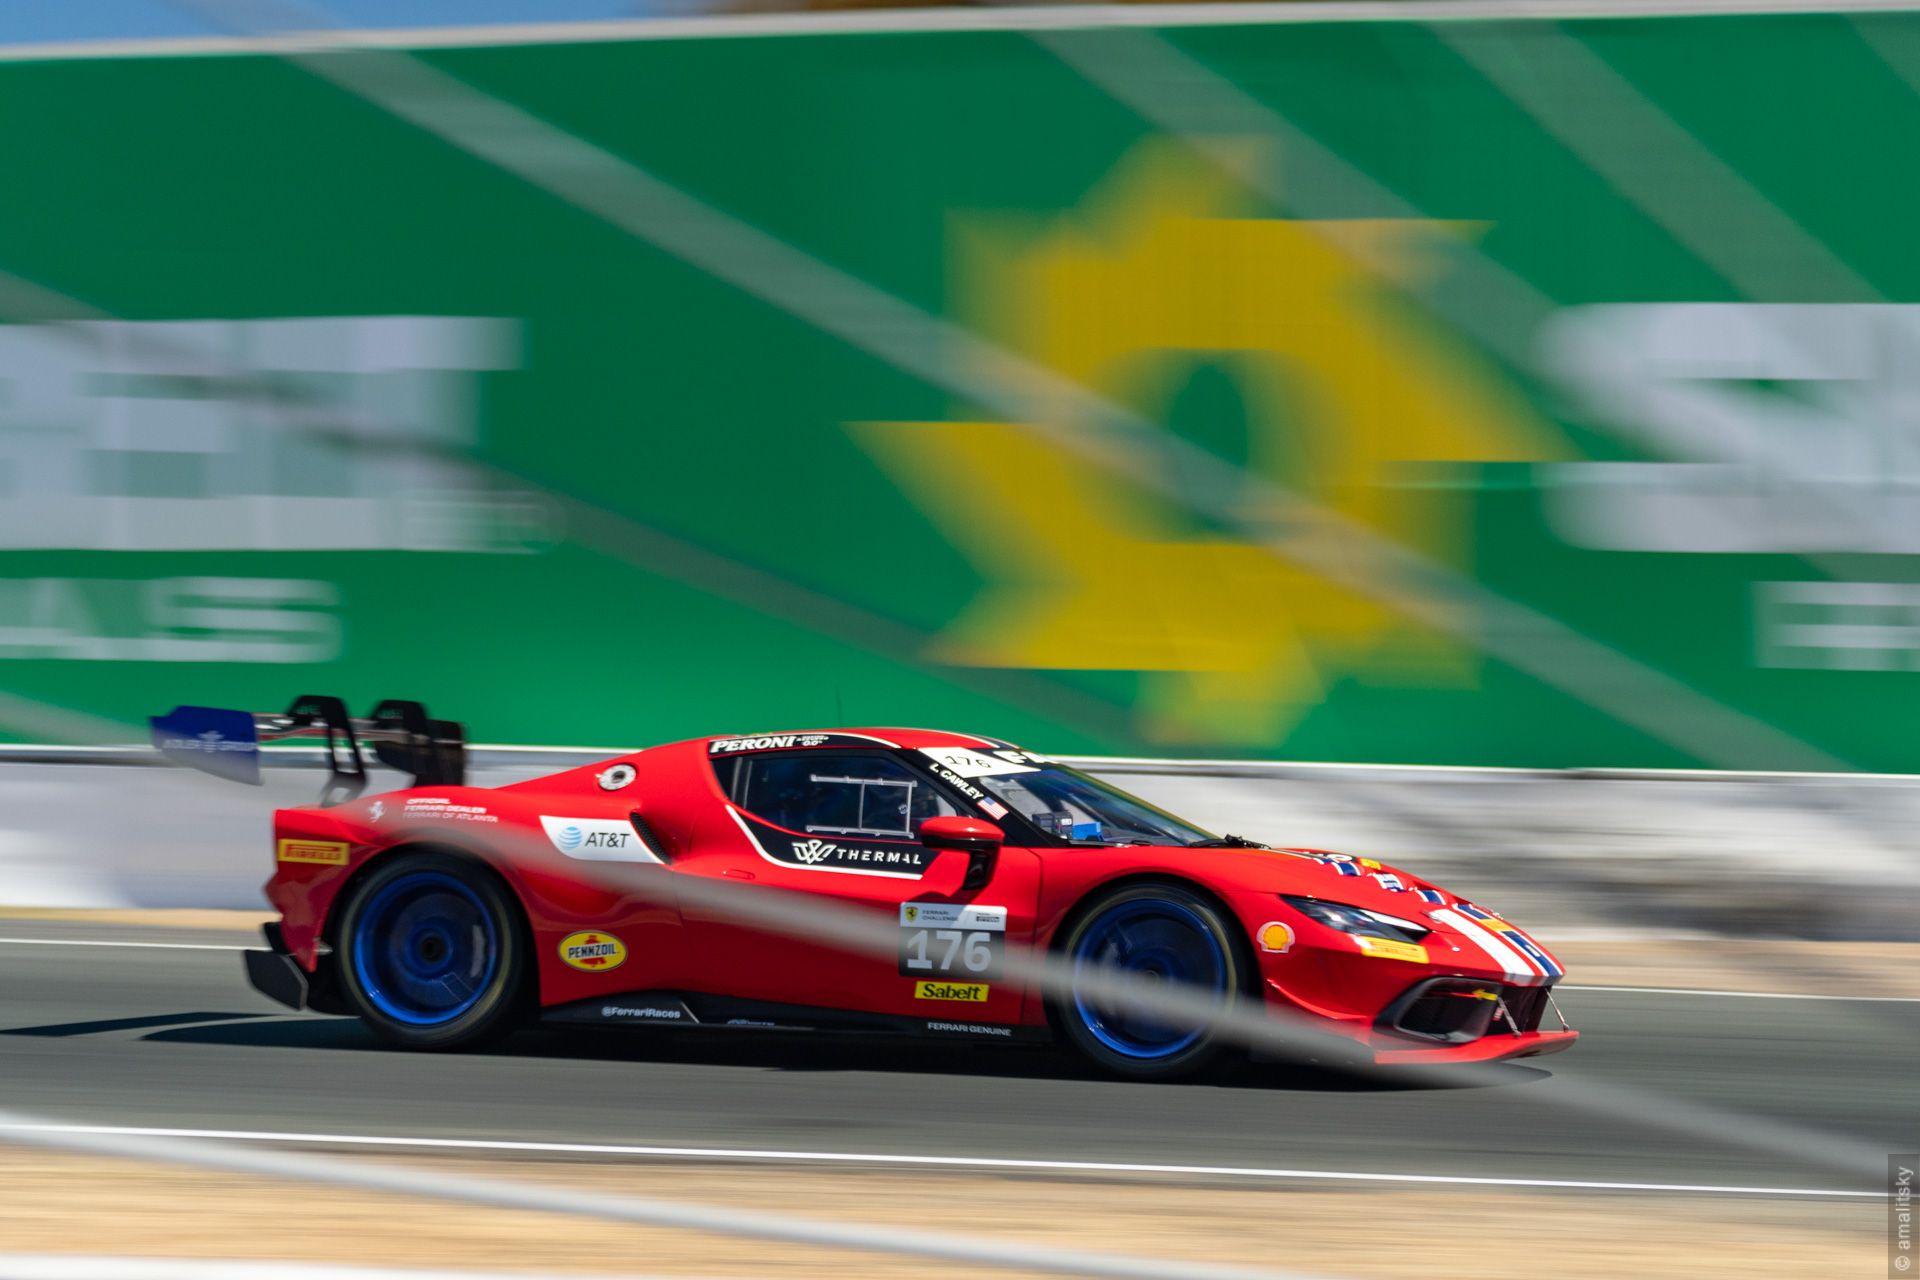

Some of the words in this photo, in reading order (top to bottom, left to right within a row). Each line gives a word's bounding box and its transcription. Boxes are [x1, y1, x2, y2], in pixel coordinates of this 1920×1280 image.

[709, 736, 797, 753] PERONI
[945, 755, 993, 769] 176
[929, 763, 939, 774] L.
[940, 771, 985, 800] CAWLEY
[446, 805, 488, 814] DEALER
[456, 813, 498, 823] ATLANTA
[584, 832, 630, 848] AT&T
[837, 849, 922, 865] THERMAL
[567, 944, 617, 959] PENNZOIL
[907, 929, 992, 972] 176
[922, 983, 981, 1000] Sabelt
[602, 1006, 680, 1019] @FerrariRaces
[927, 1022, 969, 1032] FERRARI
[969, 1025, 1012, 1036] GENUINE
